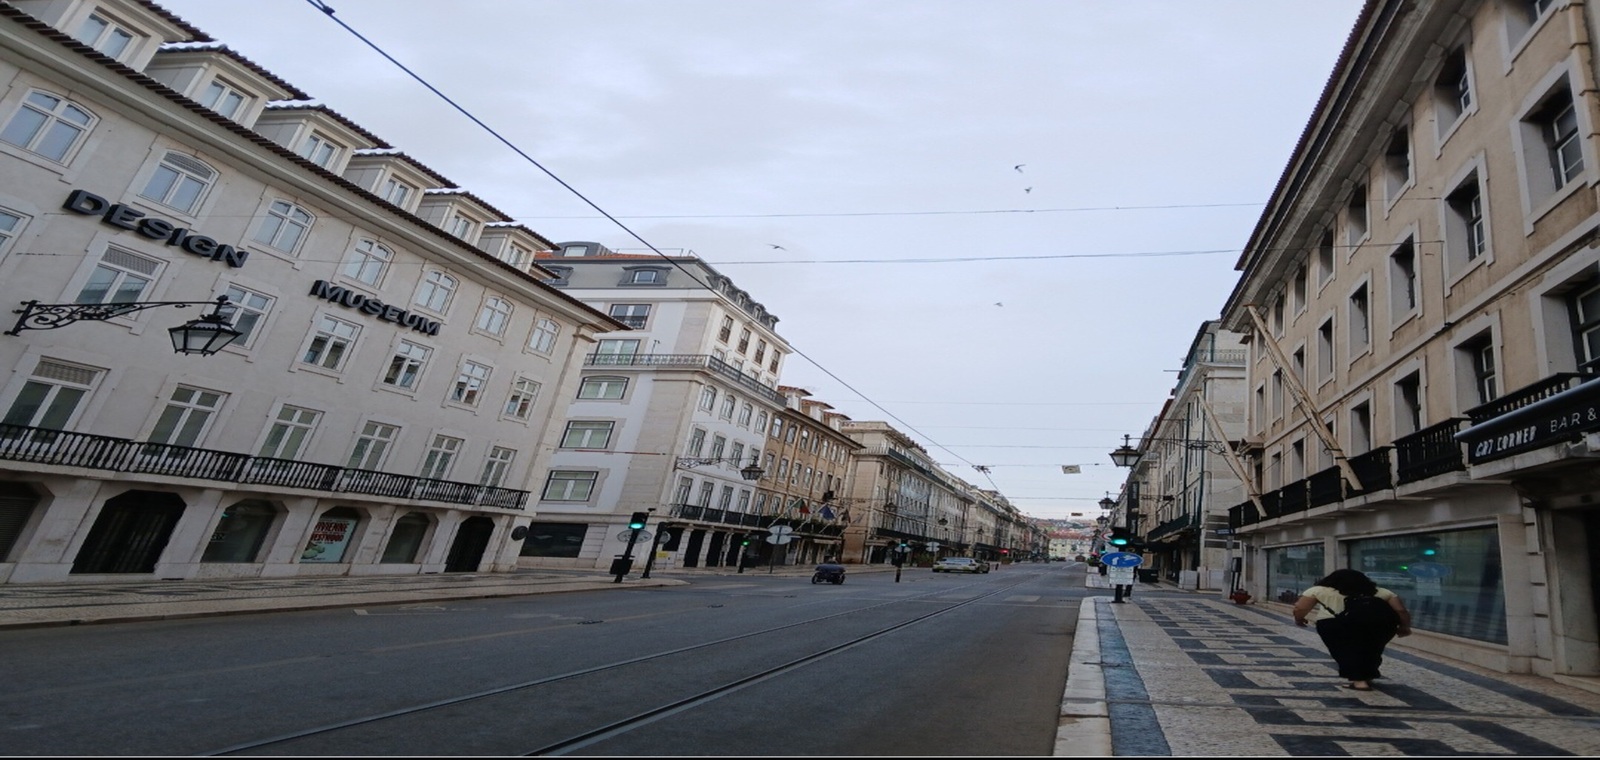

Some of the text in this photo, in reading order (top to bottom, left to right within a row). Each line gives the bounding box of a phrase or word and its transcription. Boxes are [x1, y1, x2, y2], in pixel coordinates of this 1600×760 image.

[62, 189, 249, 268] DESIGN
[309, 280, 440, 336] MUSEUM
[1497, 425, 1537, 451] CORNER
[1550, 412, 1581, 433] BAR
[1587, 407, 1597, 421] &
